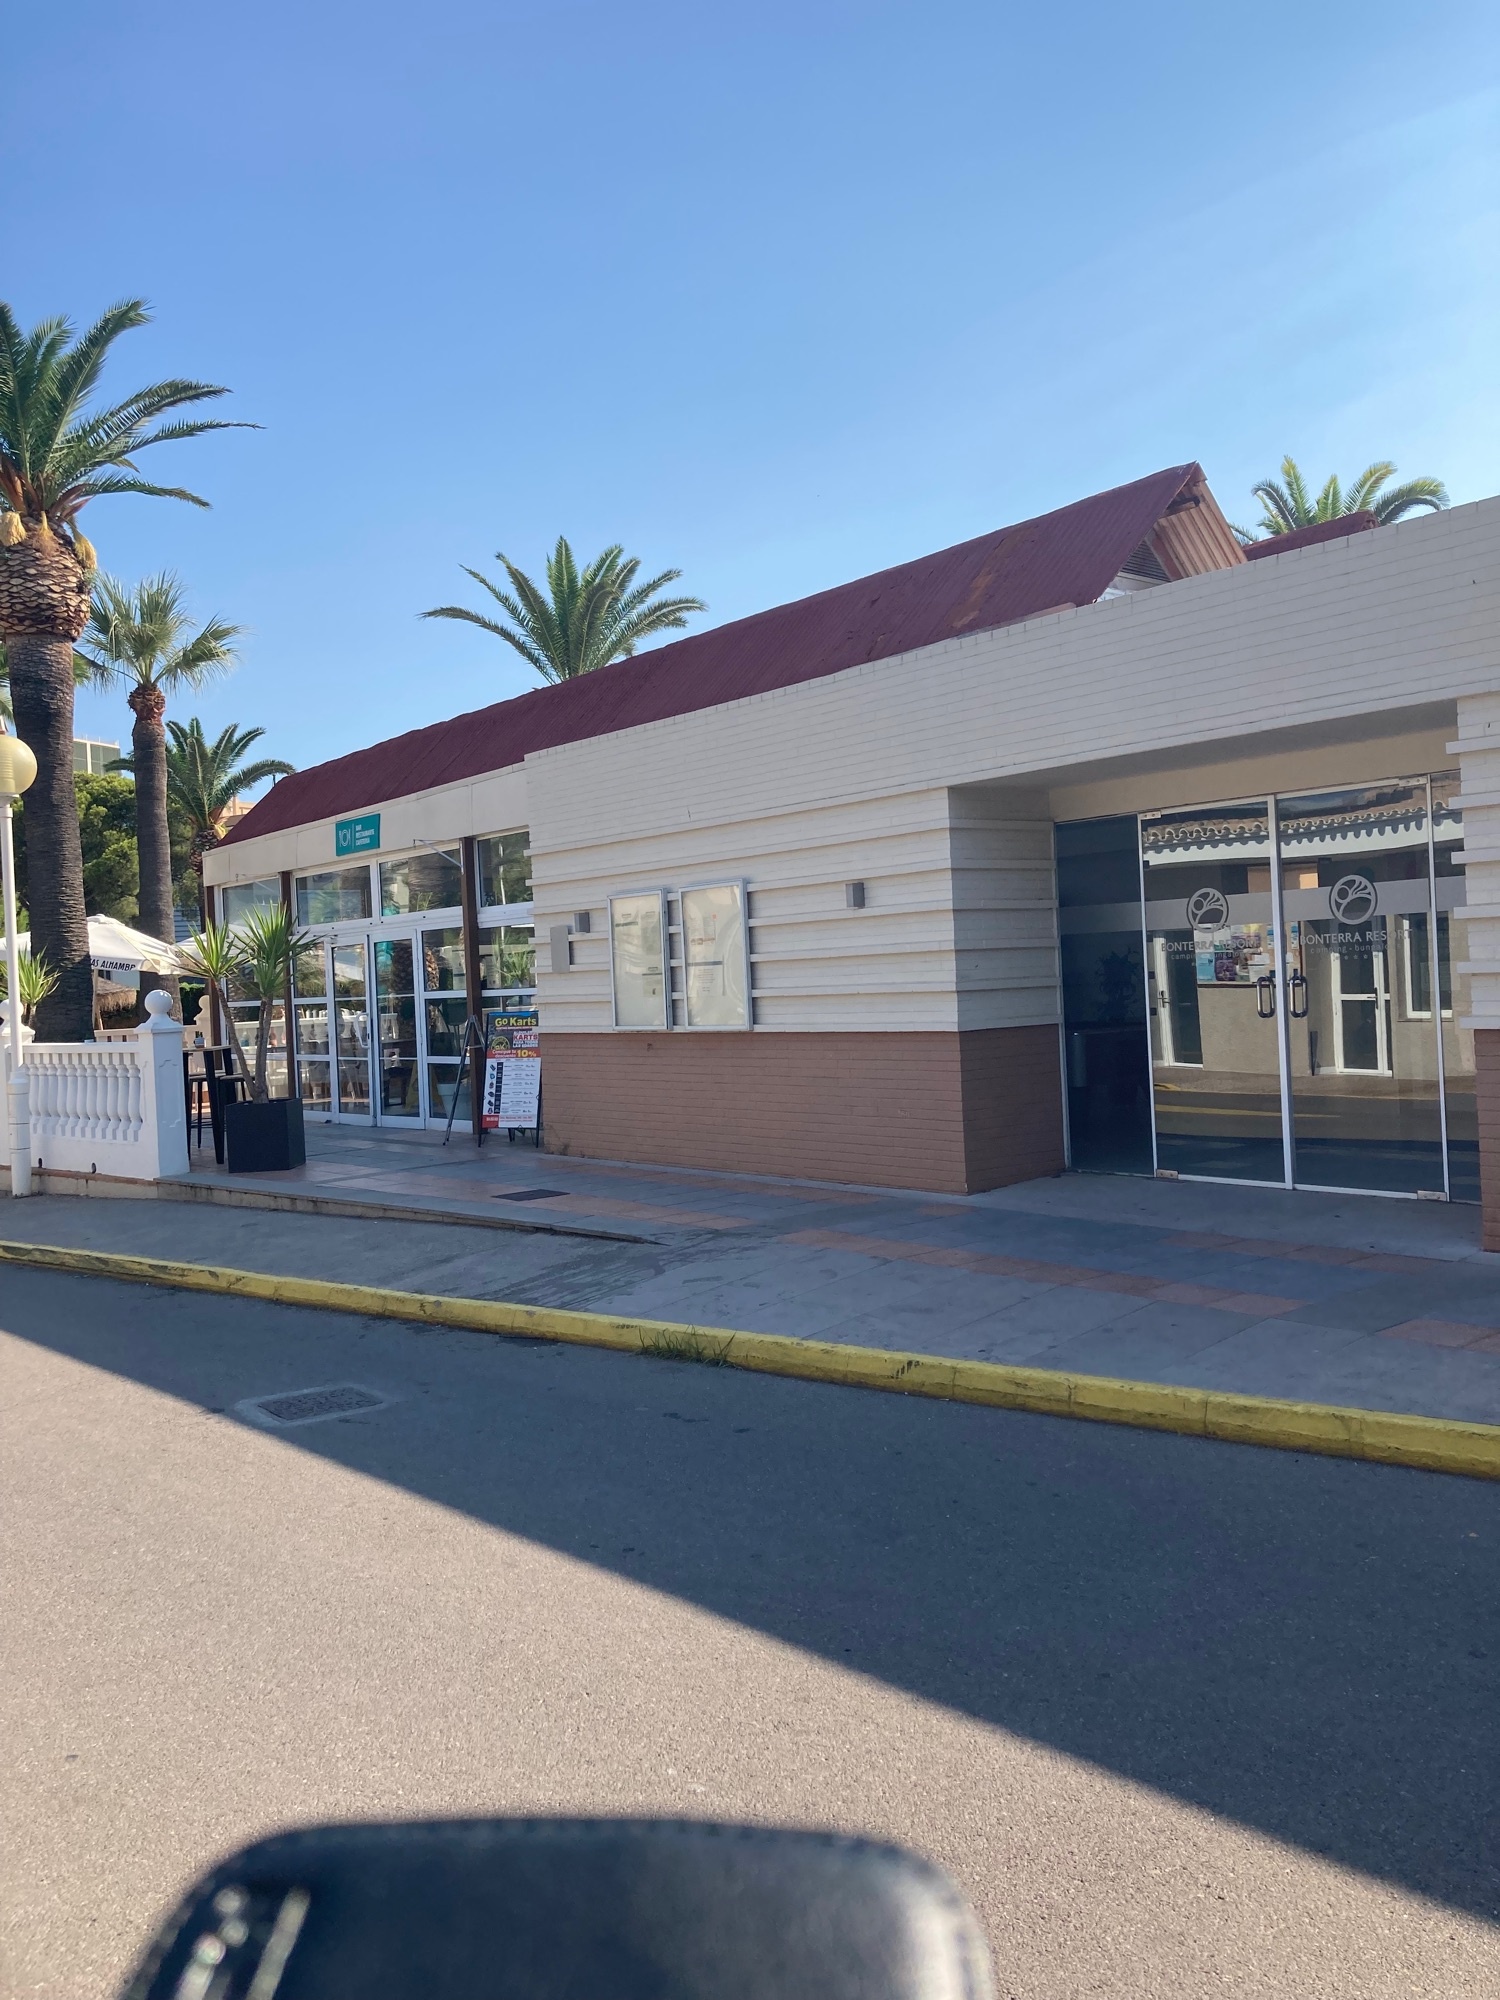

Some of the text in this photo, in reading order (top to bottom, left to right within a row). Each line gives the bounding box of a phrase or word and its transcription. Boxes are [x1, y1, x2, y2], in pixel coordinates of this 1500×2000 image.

[1299, 931, 1362, 946] BONTERRA
[1160, 939, 1214, 952] BONTERRA
[510, 1017, 537, 1026] Karts
